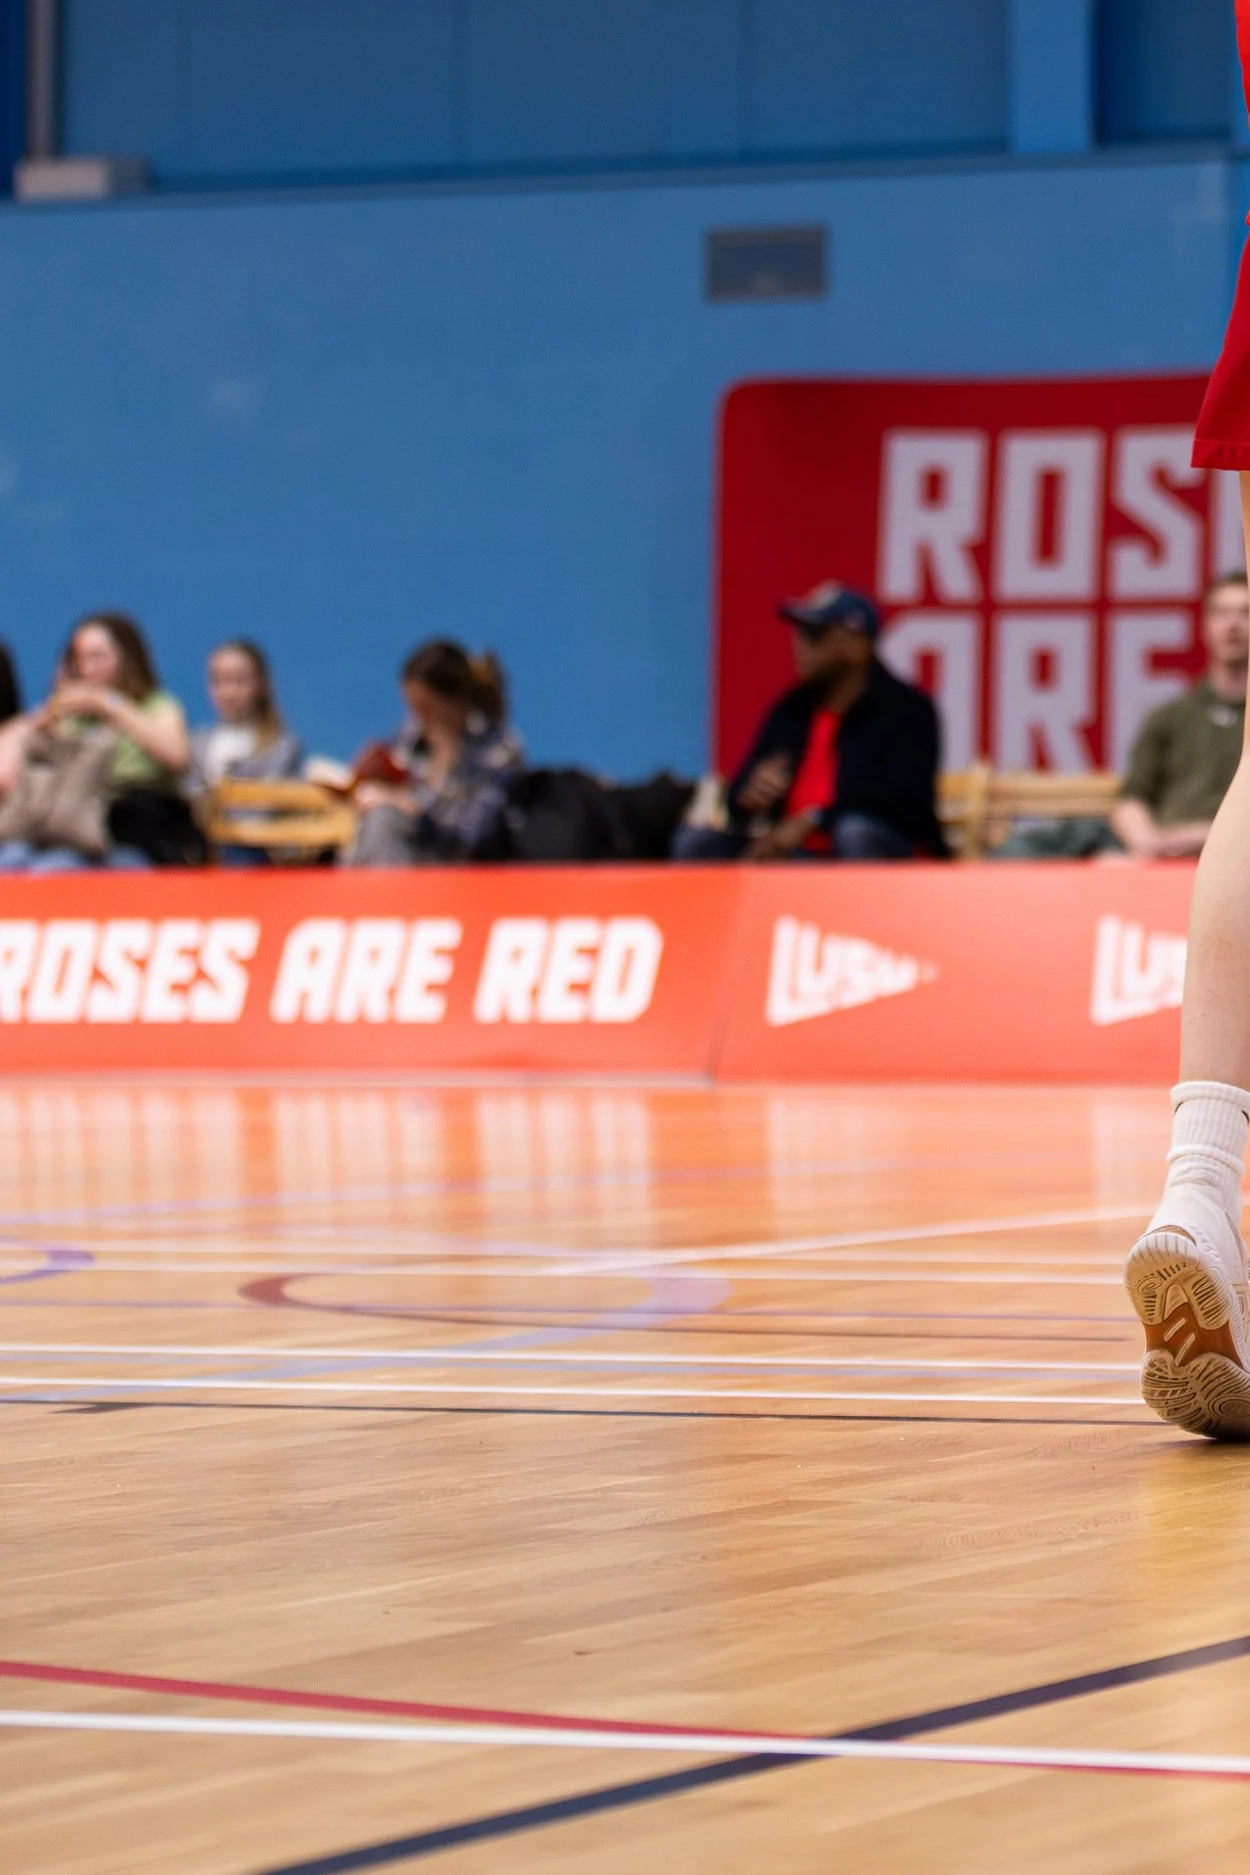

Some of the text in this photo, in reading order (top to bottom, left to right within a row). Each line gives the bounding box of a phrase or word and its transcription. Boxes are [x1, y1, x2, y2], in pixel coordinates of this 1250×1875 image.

[880, 429, 1242, 604] ROS
[0, 916, 664, 1023] ROSES ARE RED
